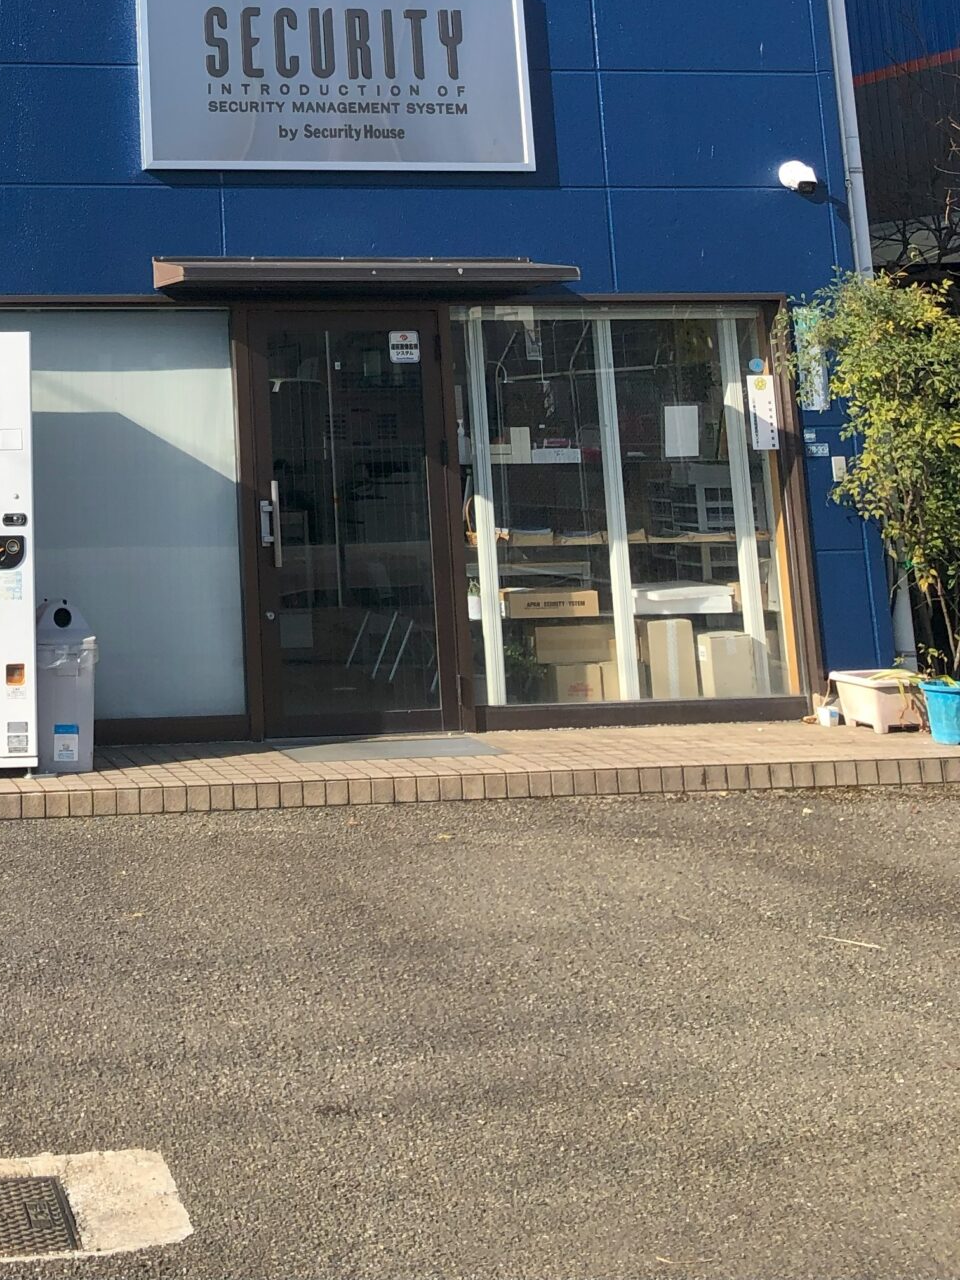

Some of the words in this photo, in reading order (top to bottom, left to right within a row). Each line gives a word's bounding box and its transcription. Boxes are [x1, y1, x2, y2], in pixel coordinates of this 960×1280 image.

[204, 6, 463, 80] SECURITY
[208, 84, 420, 96] INTRODUCTION
[437, 85, 466, 97] OF
[208, 101, 285, 113] SECURITY
[292, 102, 400, 114] MANAGEMENT
[406, 103, 468, 115] SYSTEM
[279, 125, 298, 141] by
[304, 124, 362, 141] Security
[363, 125, 405, 139] House
